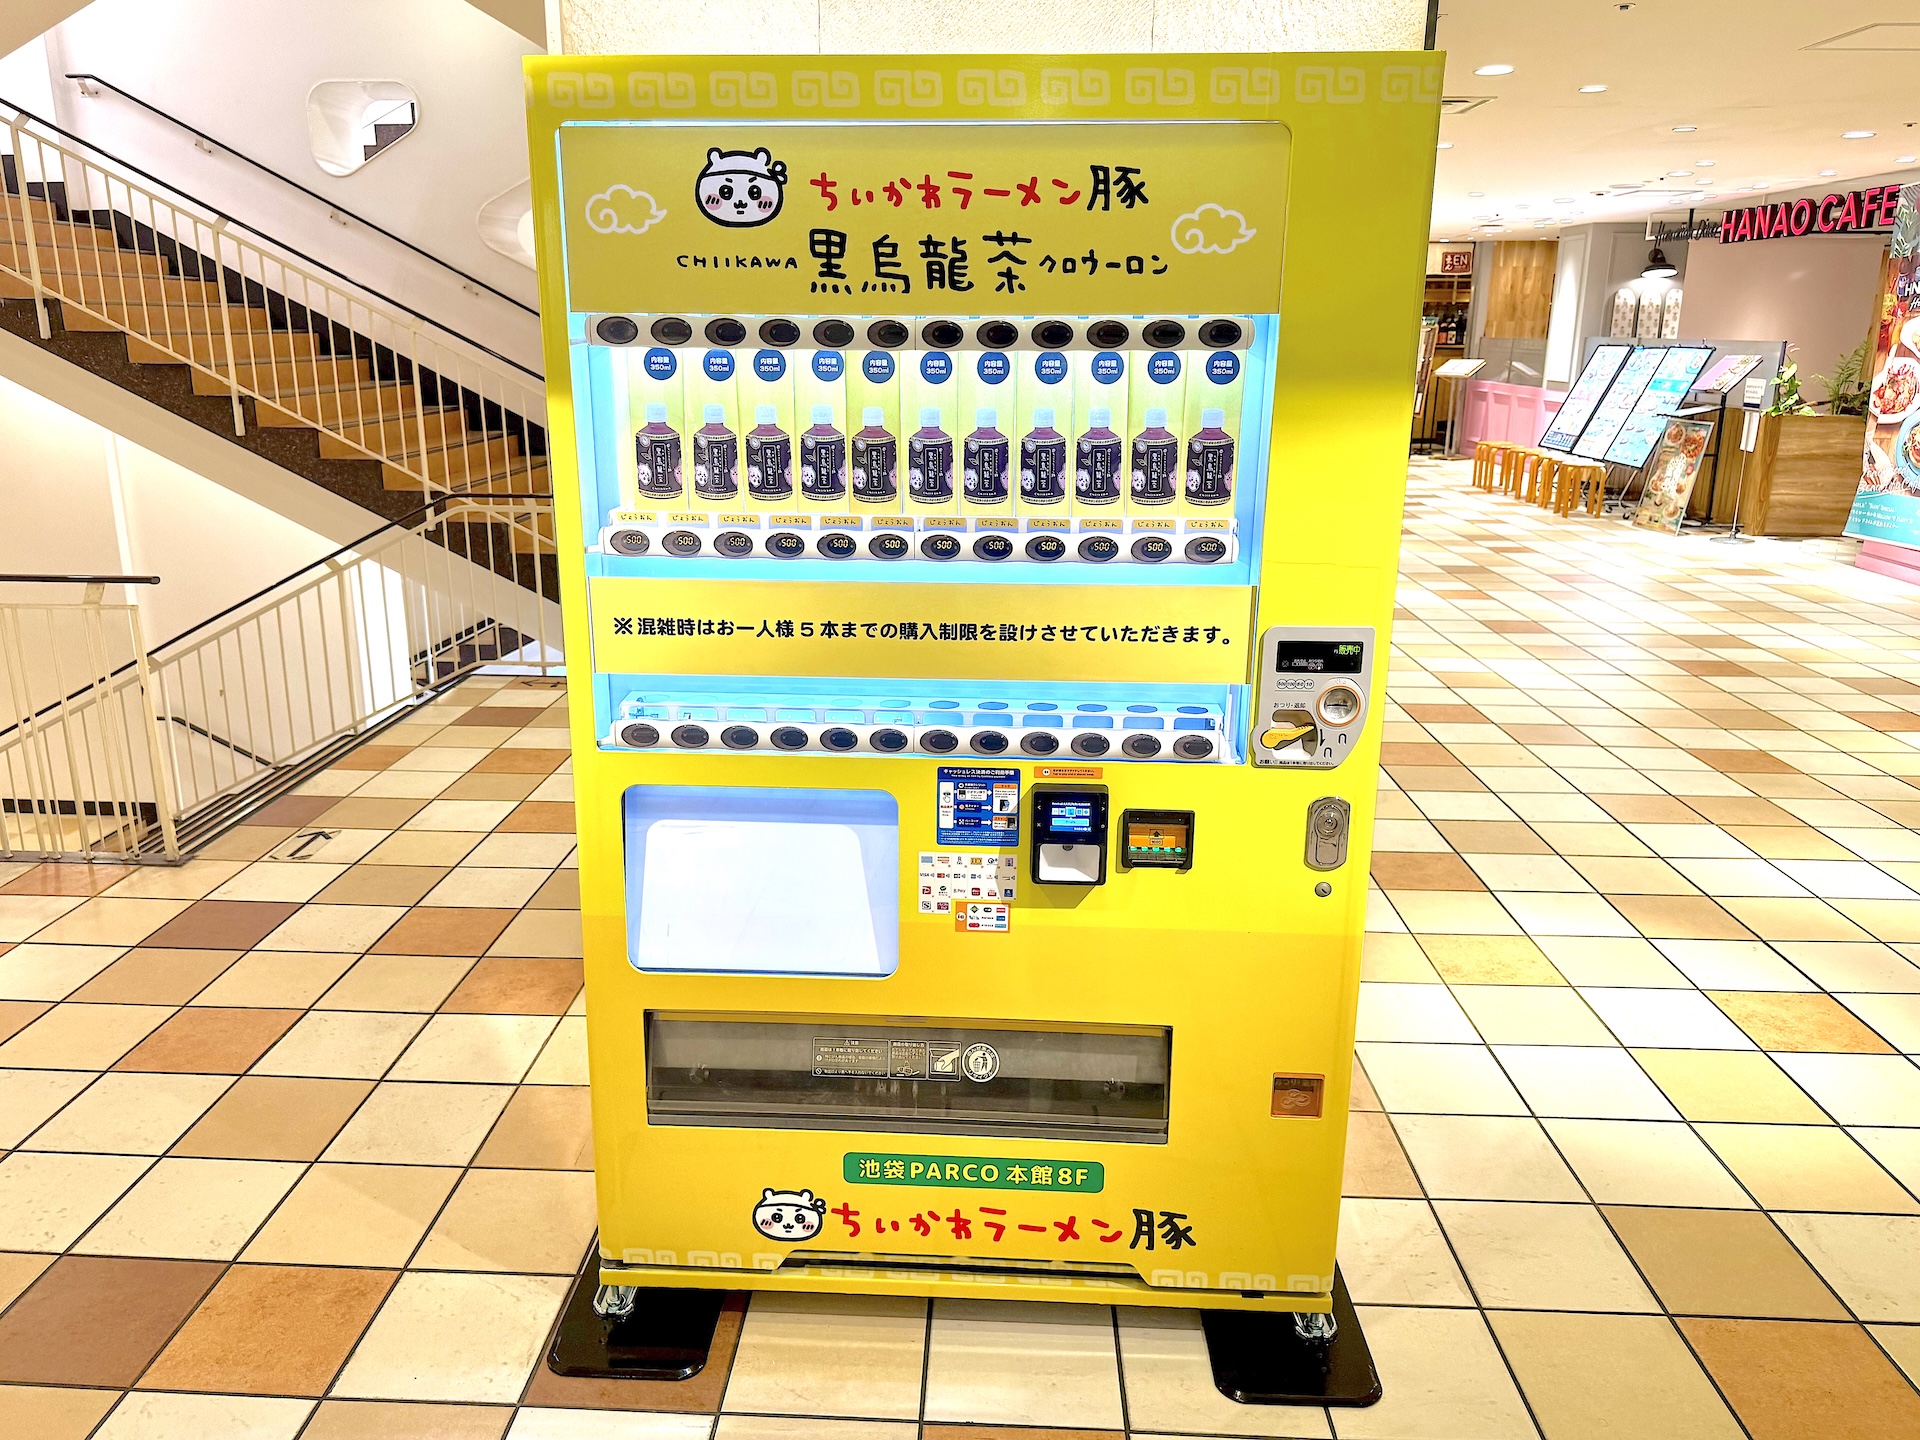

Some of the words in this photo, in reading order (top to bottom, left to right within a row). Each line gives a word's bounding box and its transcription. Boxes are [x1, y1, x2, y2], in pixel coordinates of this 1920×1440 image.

[810, 164, 1149, 211] ちいかわラーメン豚
[1720, 198, 1812, 243] HANAO
[1818, 185, 1900, 232] CAFE
[676, 254, 798, 269] CHIIKAWA
[808, 228, 1033, 295] 黒烏龍茶
[1038, 248, 1168, 276] クロウーロン
[1453, 254, 1468, 265] EN
[831, 1202, 1197, 1251] ちいかわラーメン豚
